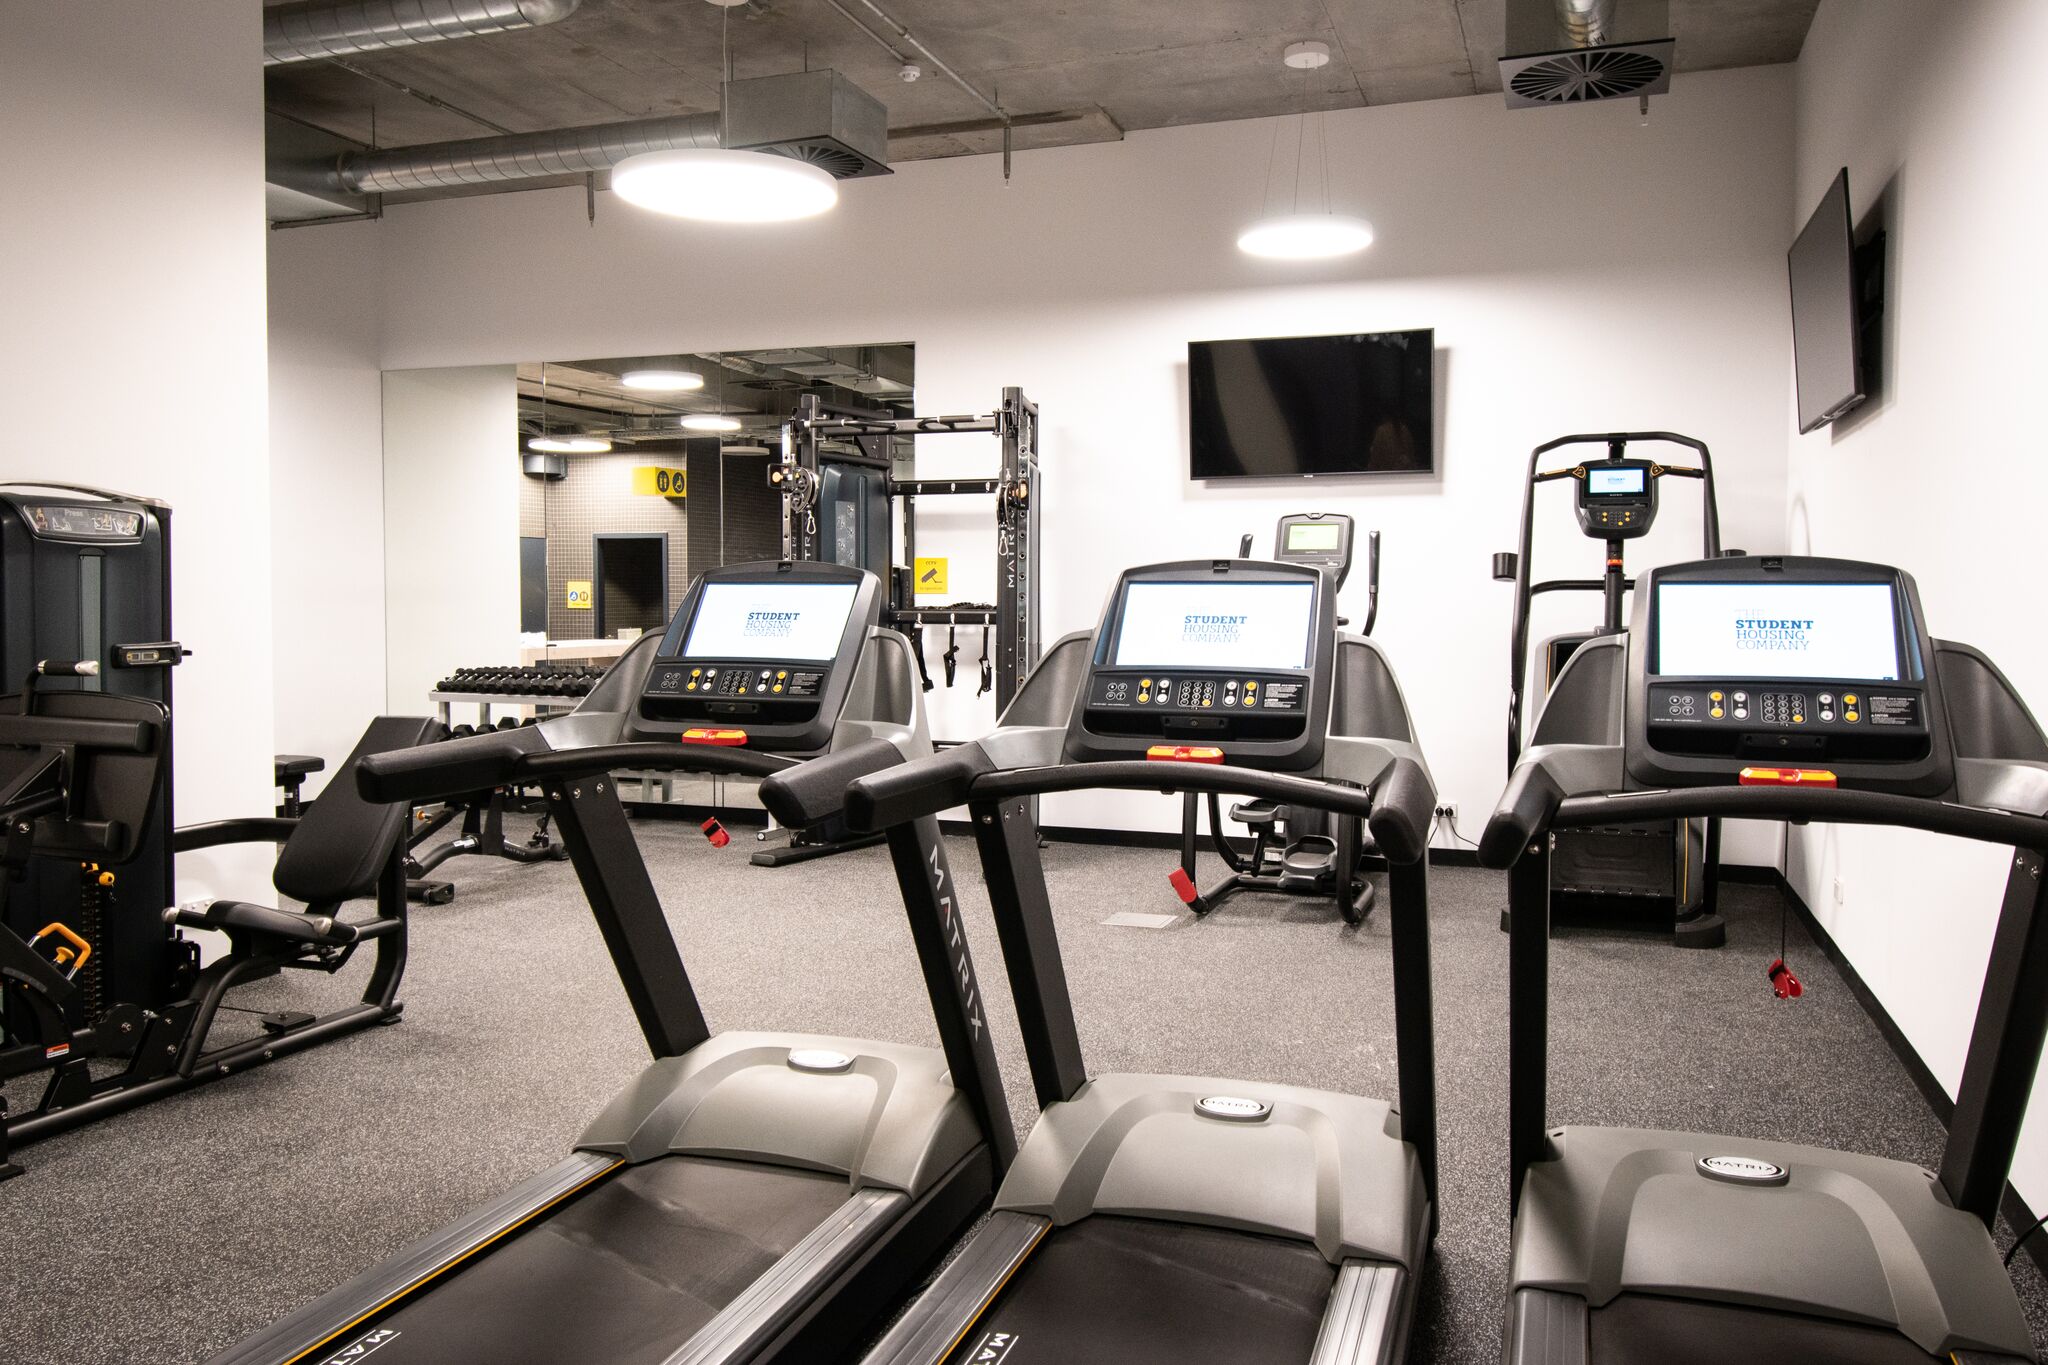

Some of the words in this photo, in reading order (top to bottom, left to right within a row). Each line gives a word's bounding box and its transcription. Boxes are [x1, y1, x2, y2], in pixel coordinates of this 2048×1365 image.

[748, 612, 800, 620] STUDENT
[1184, 615, 1248, 624] STUDENT
[745, 620, 792, 629] HOUSING
[1183, 624, 1239, 633] HOUSING
[1735, 619, 1814, 629] STUDENT
[743, 629, 793, 637] COMPANY
[1181, 633, 1241, 643] COMPANY
[1736, 629, 1805, 640] HOUSING
[1736, 640, 1810, 650] COMPANY
[930, 844, 982, 1041] MATRIX
[1709, 1160, 1774, 1171] MATRIX
